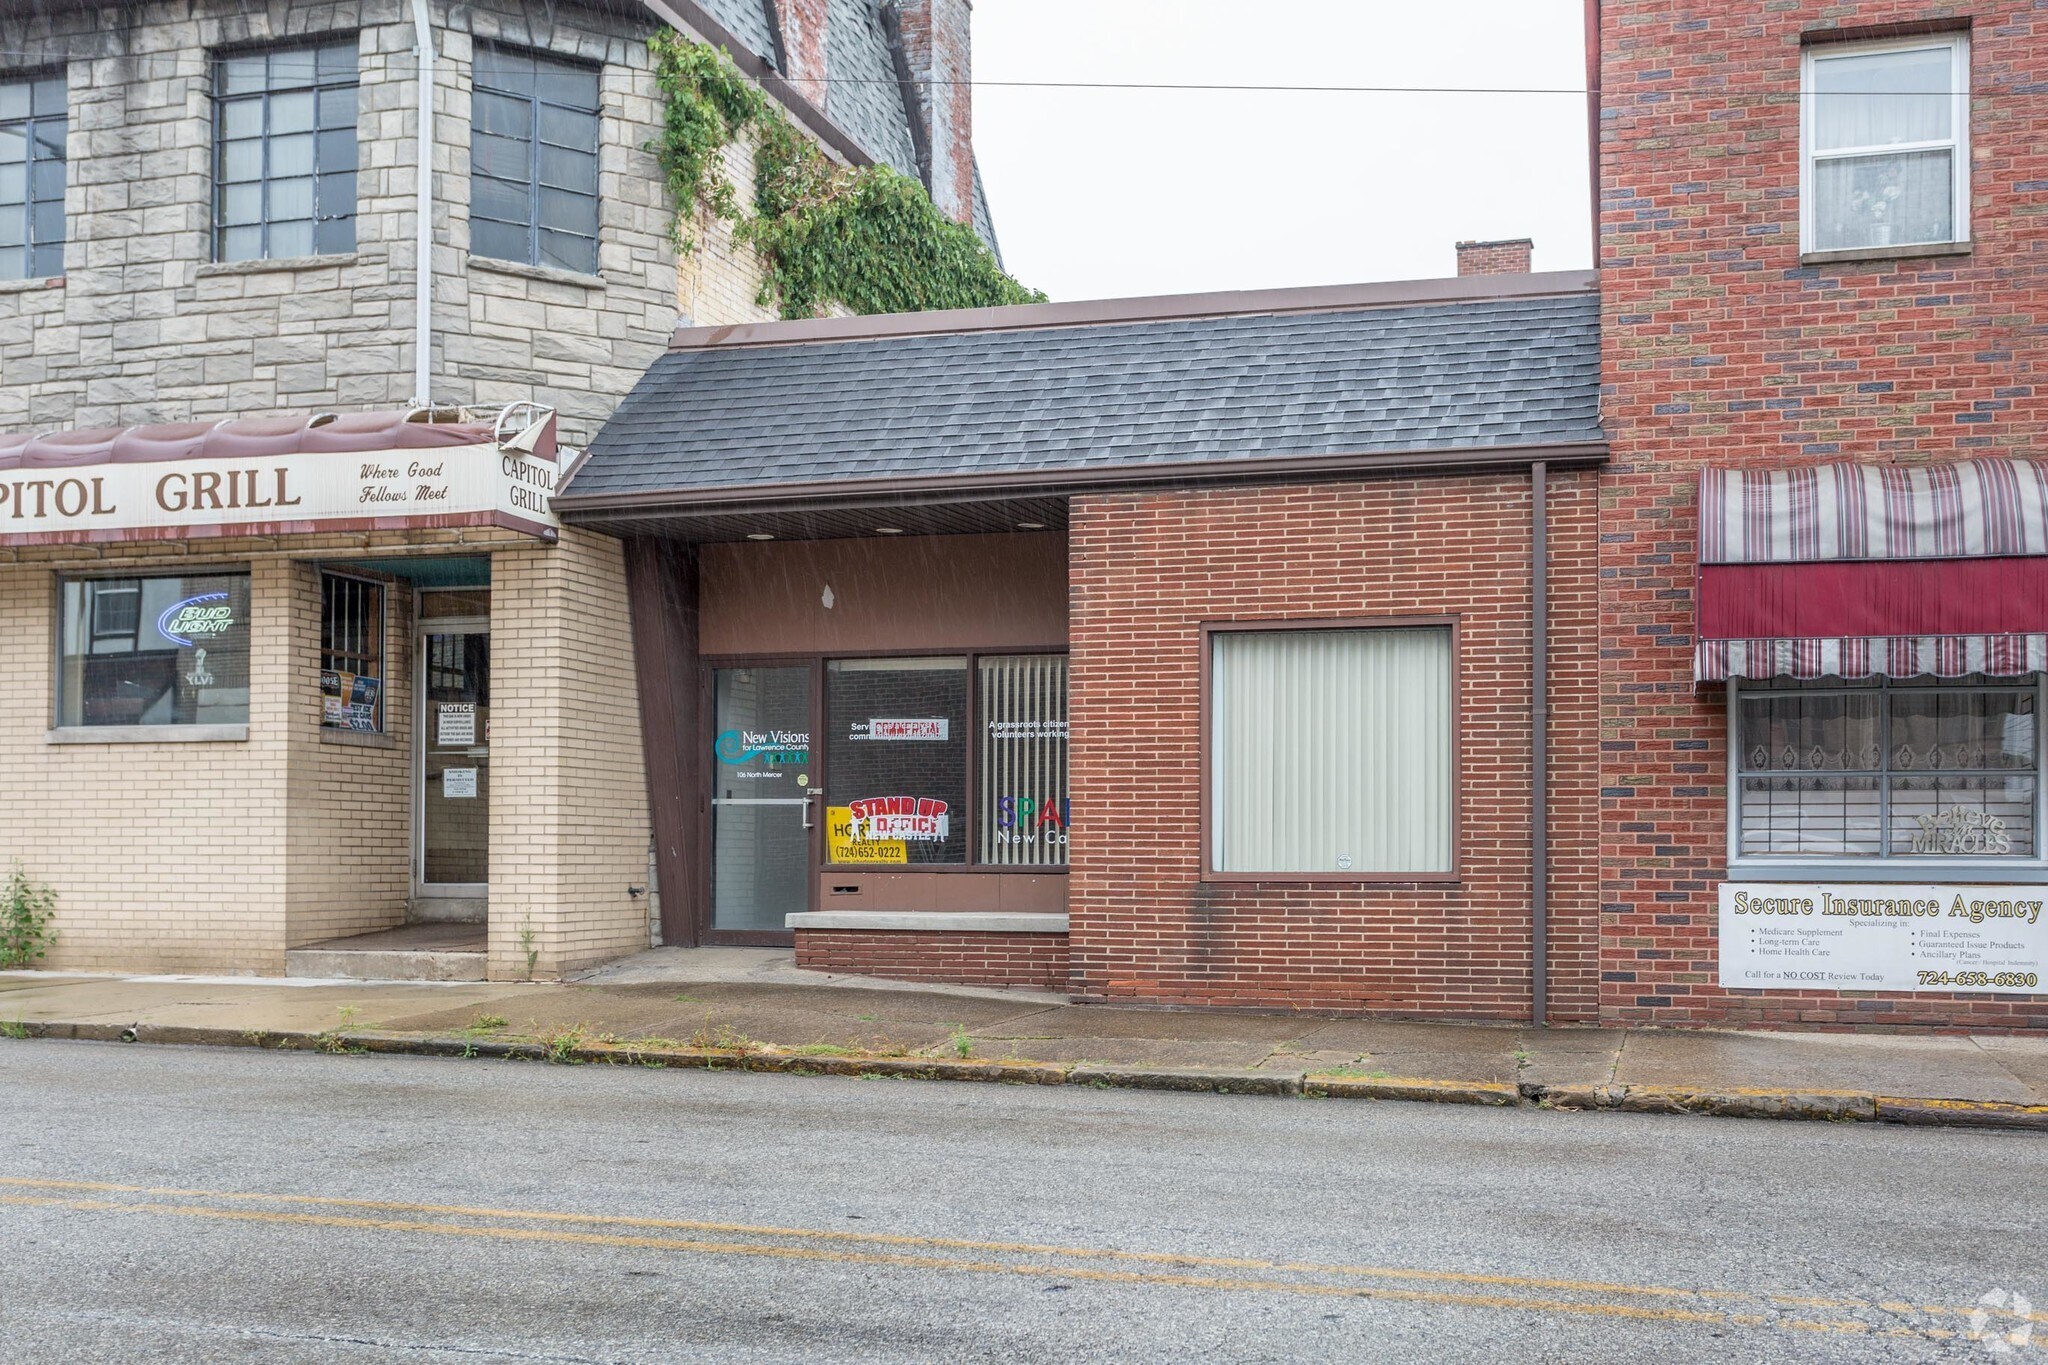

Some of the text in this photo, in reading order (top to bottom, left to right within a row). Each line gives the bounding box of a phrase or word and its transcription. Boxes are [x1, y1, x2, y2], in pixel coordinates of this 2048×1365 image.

[360, 461, 444, 480] Where Good
[502, 456, 553, 491] CAPITOL
[155, 468, 301, 512] GRILL
[359, 484, 448, 503] Fellows Meet
[510, 485, 546, 514] GRILL
[179, 606, 231, 621] BUD
[168, 619, 234, 633] LIGHT
[440, 704, 475, 713] NOTICE
[989, 720, 996, 729] A
[997, 720, 1041, 730] grassroots
[742, 730, 809, 744] New Visions
[992, 729, 1070, 739] volunteers working
[752, 743, 785, 751] Lawrence
[785, 743, 809, 752] County
[849, 796, 948, 820] STAND UP
[997, 830, 1035, 844] New
[835, 846, 901, 858] (724)652-0222
[1734, 891, 2043, 924] Secure Insurance Agency
[1849, 919, 1910, 929] Specializing in:
[1758, 927, 1843, 938] Medicare Supplement
[1920, 929, 1981, 940] Final Expenses
[1758, 938, 1820, 947] Long-term Care
[1918, 939, 2025, 949] Guaranteed Issue Products
[1758, 947, 1831, 957] Home Health Care
[1919, 950, 1981, 960] Ancillary Plans
[1744, 970, 1761, 979] Call
[1763, 970, 1775, 979] for
[1783, 971, 1798, 980] NO
[1800, 971, 1826, 980] COST
[1828, 972, 1858, 981] Review
[1859, 972, 1885, 982] Today
[1917, 971, 2038, 987] 724-658-6830
